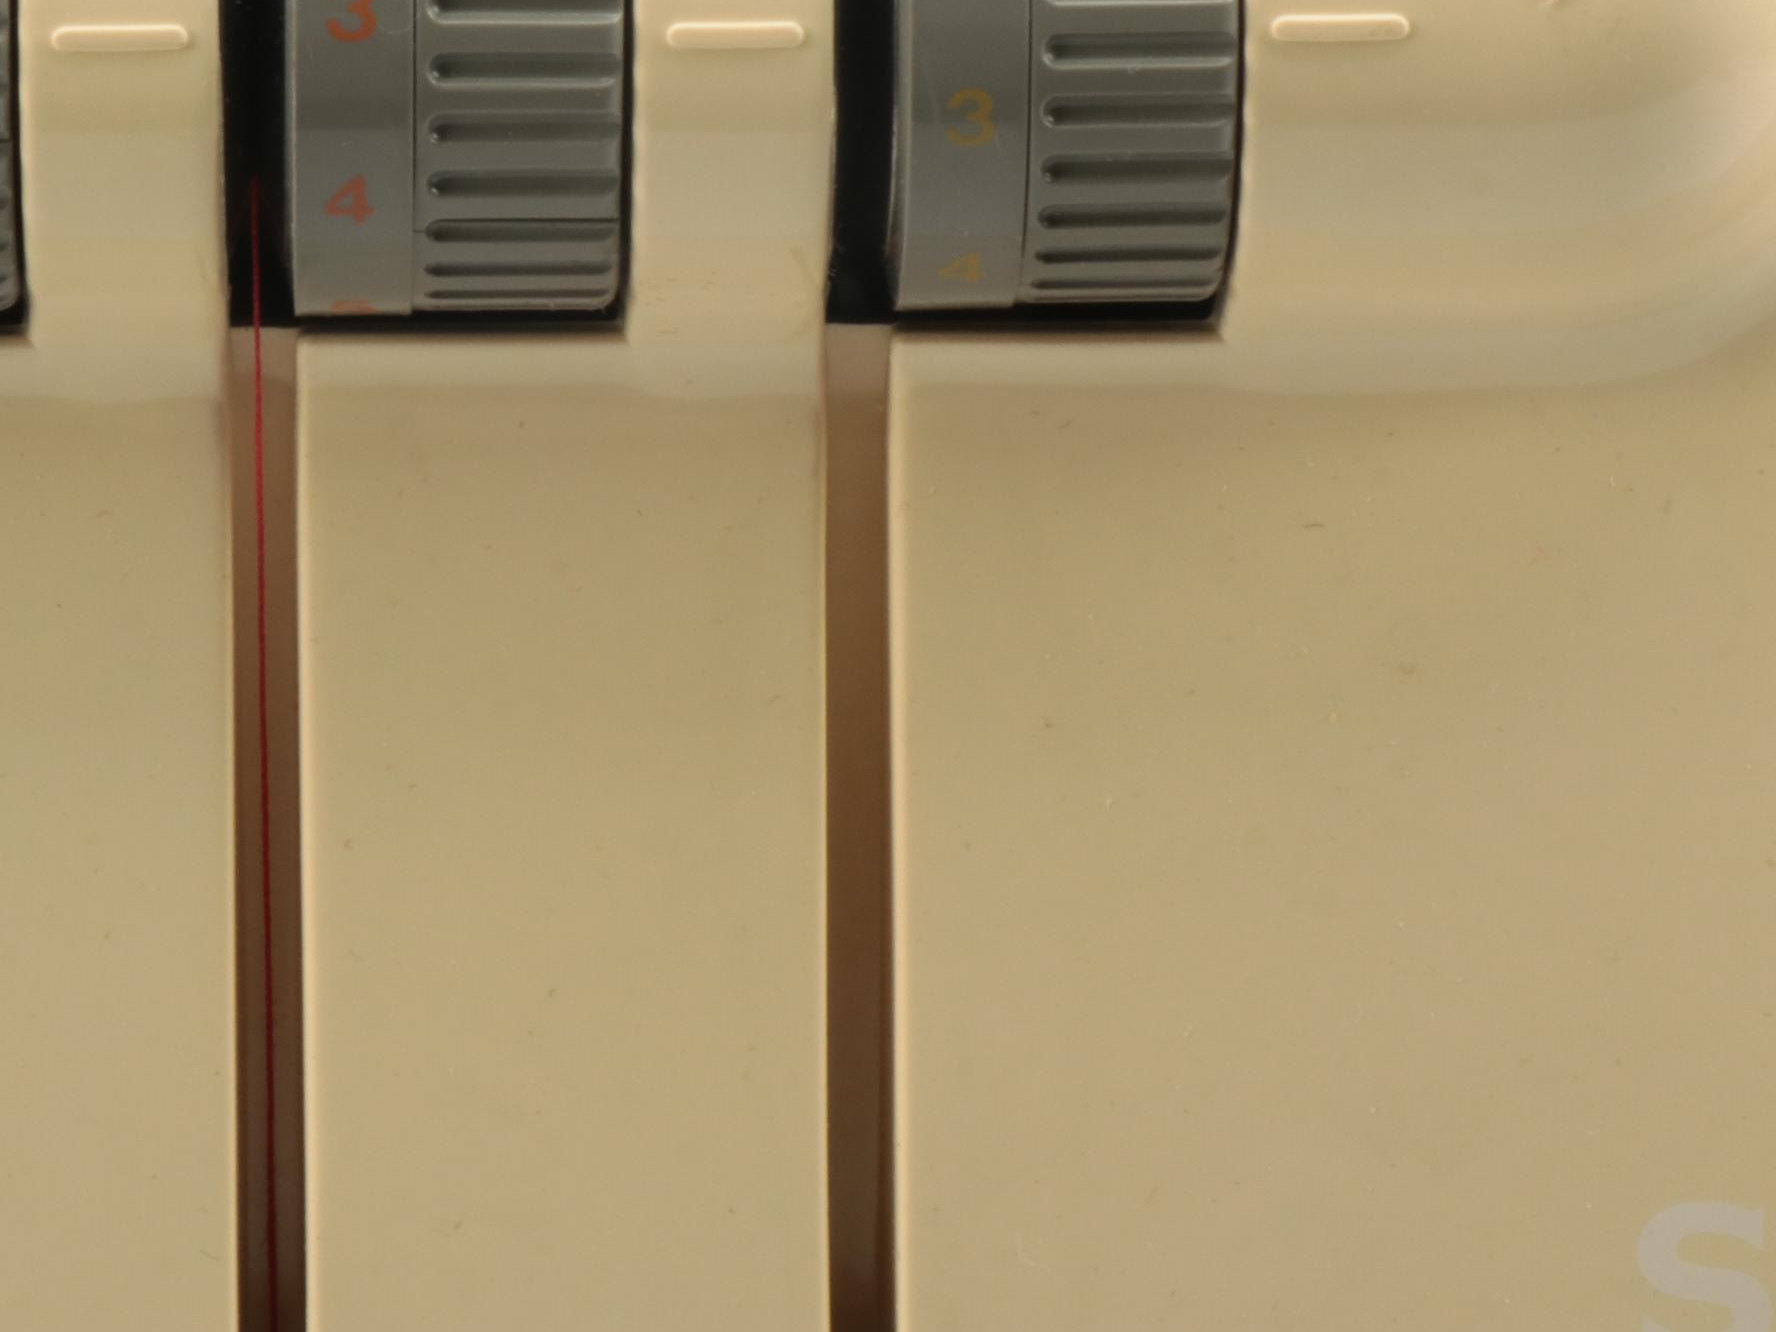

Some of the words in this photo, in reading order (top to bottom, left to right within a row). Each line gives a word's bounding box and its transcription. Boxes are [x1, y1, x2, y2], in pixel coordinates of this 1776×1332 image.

[944, 85, 996, 148] 3
[324, 176, 376, 225] 4
[937, 252, 982, 284] 4
